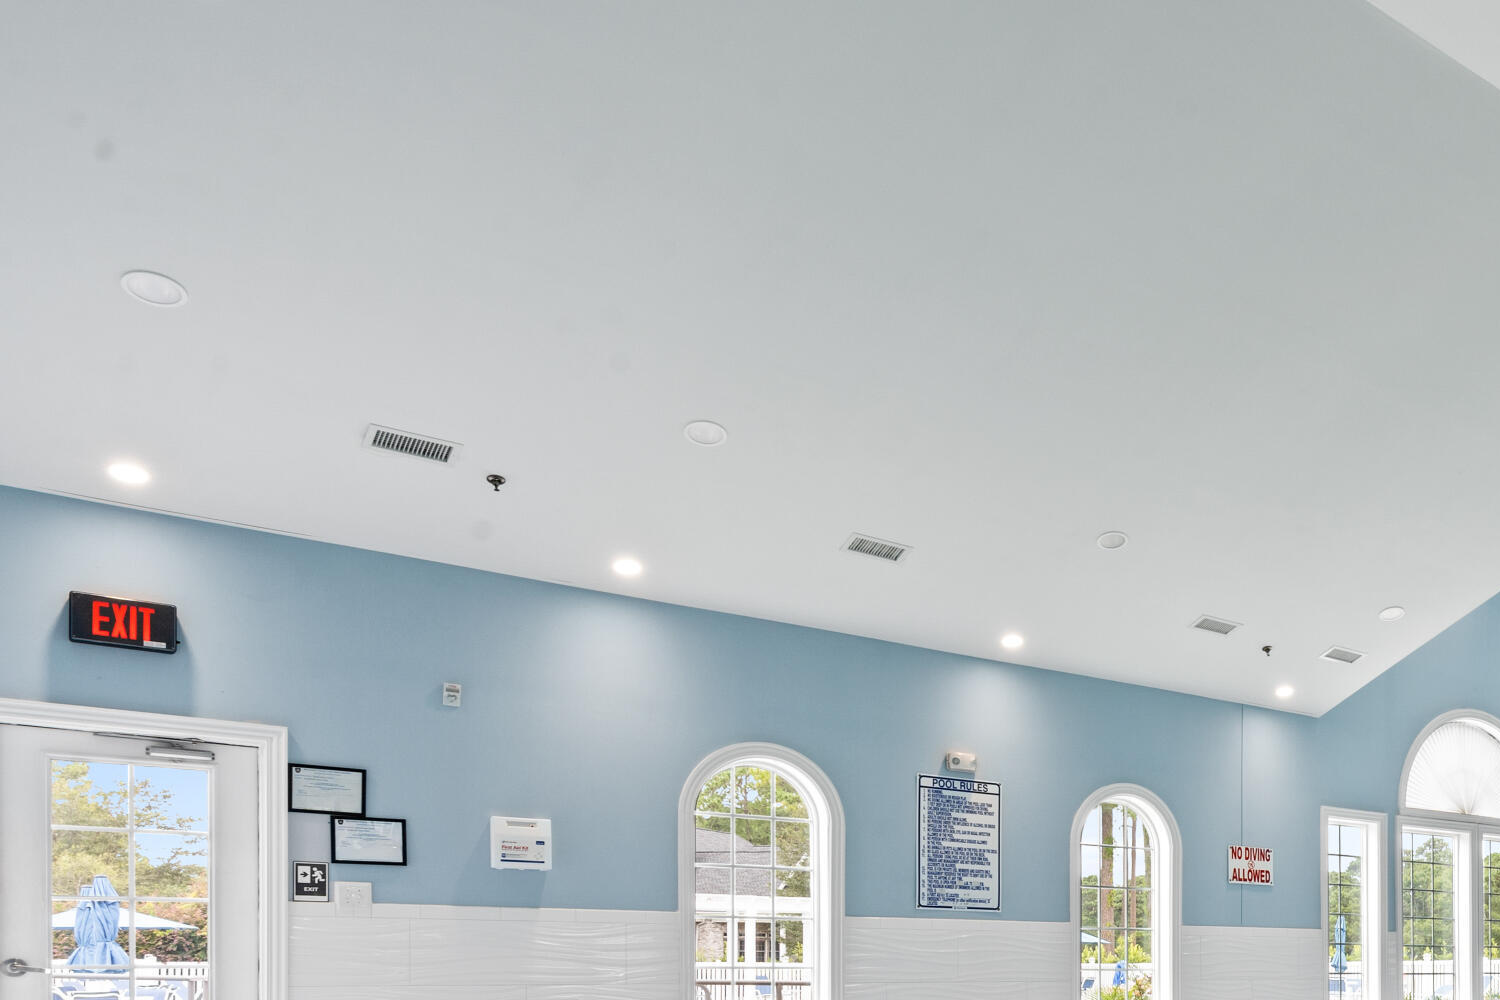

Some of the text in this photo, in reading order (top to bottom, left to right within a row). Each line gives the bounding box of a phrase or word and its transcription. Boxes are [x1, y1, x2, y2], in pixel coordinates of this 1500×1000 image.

[92, 600, 156, 642] EXIT
[932, 778, 989, 793] POOL RULES
[1231, 846, 1271, 862] NO DIVING
[1232, 867, 1271, 884] ALLOWED
